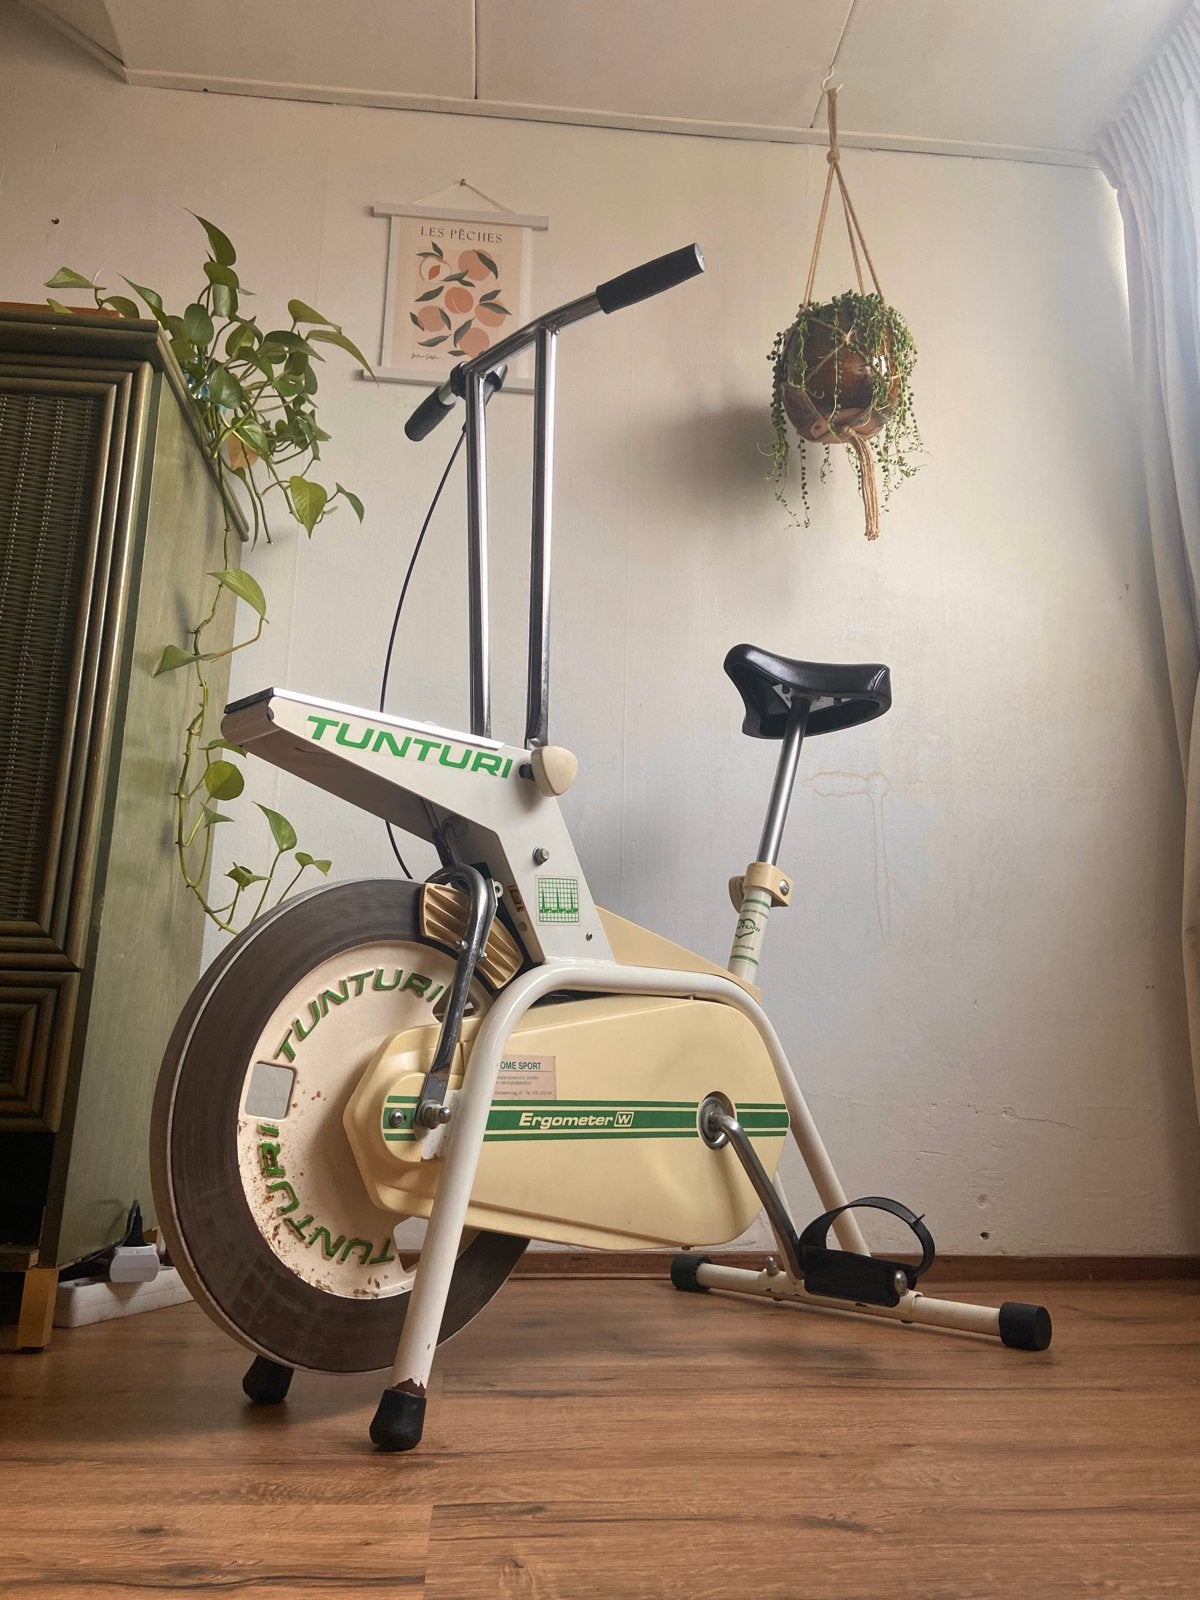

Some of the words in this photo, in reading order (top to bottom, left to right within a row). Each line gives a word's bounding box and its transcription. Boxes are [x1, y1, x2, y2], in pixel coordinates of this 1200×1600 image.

[420, 225, 444, 238] LES
[450, 228, 503, 243] PÊCHES
[307, 715, 513, 779] TUNTURI
[274, 967, 444, 1063] TUNTURI
[500, 1061, 517, 1070] OME
[518, 1061, 542, 1070] SPORT
[518, 1112, 613, 1130] Ergometer
[616, 1113, 633, 1126] W
[257, 1123, 395, 1266] TUNTURI
